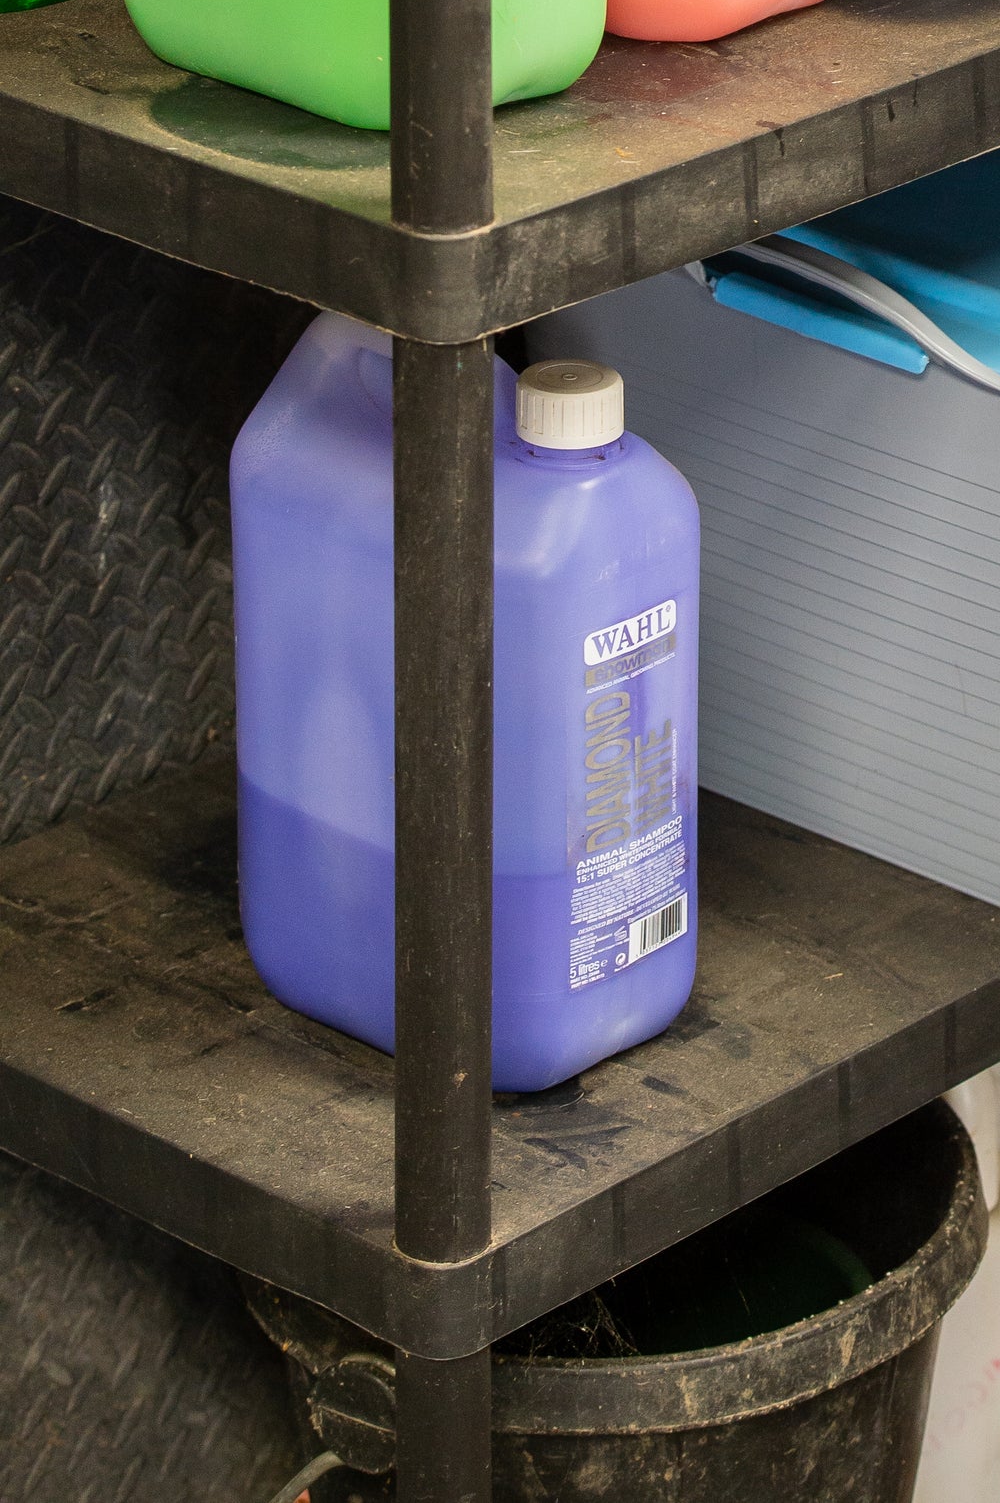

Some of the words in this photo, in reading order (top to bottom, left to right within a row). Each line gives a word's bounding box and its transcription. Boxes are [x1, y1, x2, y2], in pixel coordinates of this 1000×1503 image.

[592, 606, 670, 658] WAHL
[585, 691, 631, 853] DIAMOND
[634, 718, 672, 835] WHITE
[576, 846, 627, 870] ANIMAL
[630, 816, 682, 851] SHAMPOO
[576, 857, 617, 876] ENHANCED
[619, 840, 654, 863] WHITENING
[655, 824, 682, 845] FORMULA
[576, 873, 594, 883] 15:1
[597, 859, 627, 877] SUPER
[629, 831, 682, 865] CONCENTRATE
[578, 960, 600, 975] litres
